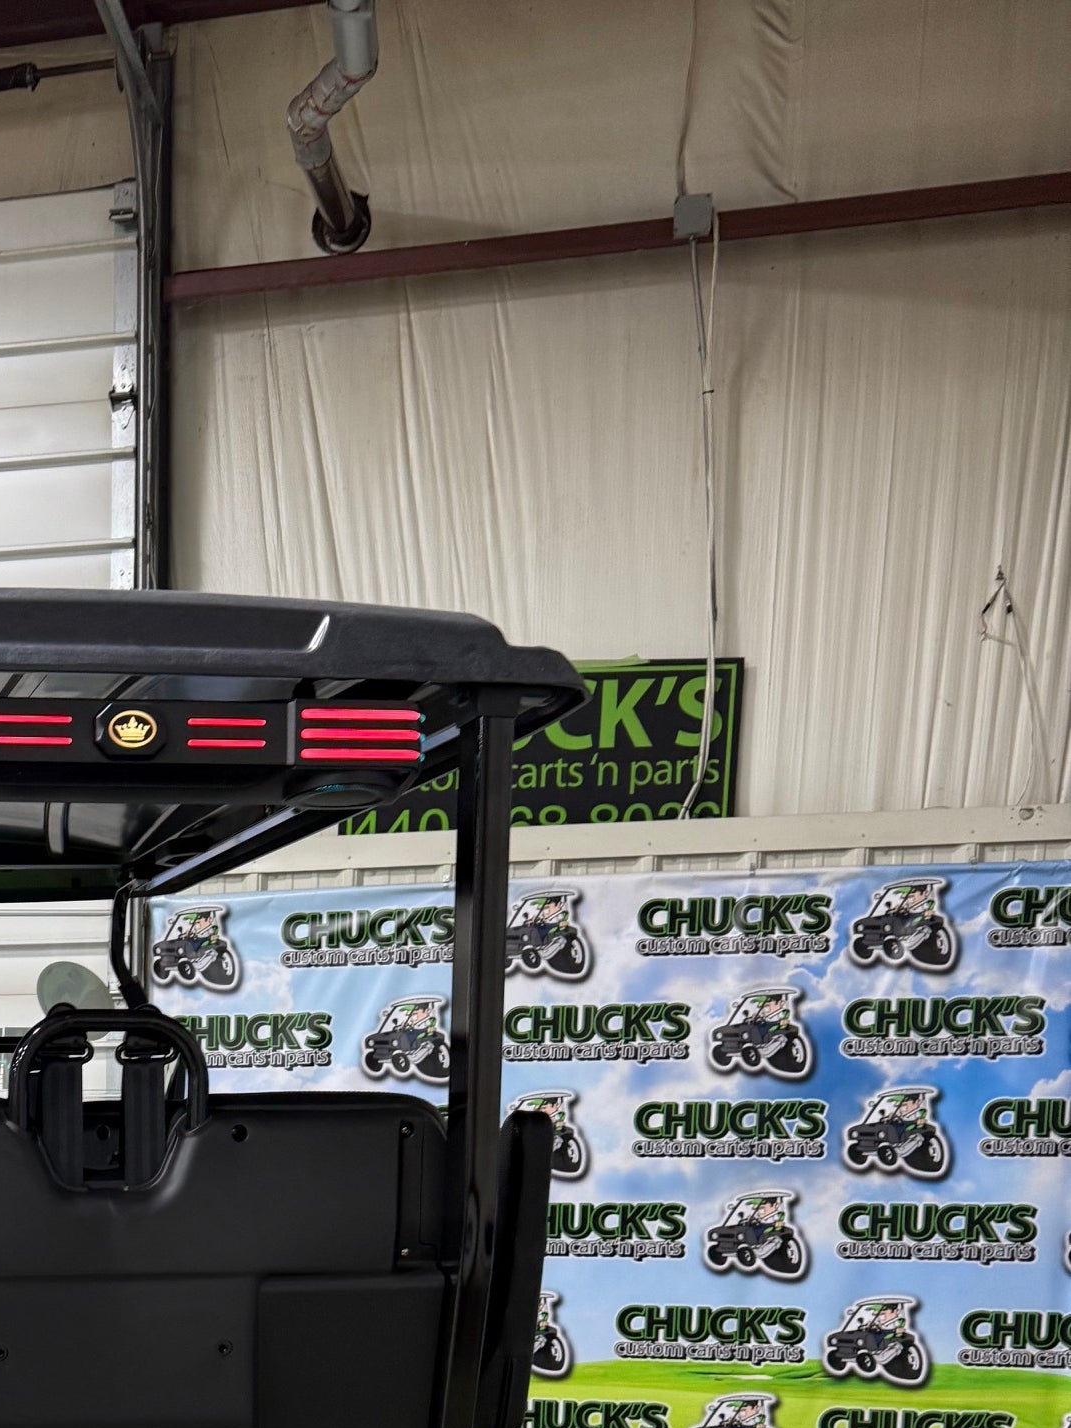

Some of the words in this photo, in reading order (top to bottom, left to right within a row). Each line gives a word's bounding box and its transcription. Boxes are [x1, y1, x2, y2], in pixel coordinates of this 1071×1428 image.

[628, 758, 720, 795] parts
[281, 905, 454, 950] CHUCK'S
[638, 894, 832, 937] CHUCK'S
[636, 937, 709, 956] custom
[776, 933, 829, 957] parts
[987, 927, 1066, 948] custom
[281, 949, 345, 967] custom
[503, 1003, 691, 1042] CHUCK'S
[844, 996, 1046, 1038] CHUCK'S
[175, 1012, 332, 1050] HUCK'S
[503, 1043, 572, 1061] custom
[637, 1040, 690, 1064] parts
[841, 1037, 917, 1056] custom
[986, 1035, 1044, 1059] parts
[284, 1049, 331, 1070] parts
[633, 1101, 827, 1140] CHUCK'S
[632, 1138, 705, 1157] custom
[771, 1137, 825, 1161] parts
[979, 1138, 1057, 1157] custom
[838, 1203, 1038, 1243] CHUCK'S
[634, 1239, 686, 1261] parts
[837, 1241, 911, 1259] custom
[980, 1241, 1035, 1265] parts
[616, 1305, 806, 1344] CHUCK'S
[614, 1341, 686, 1361] custom
[752, 1343, 805, 1365] parts
[957, 1348, 1034, 1368] custom
